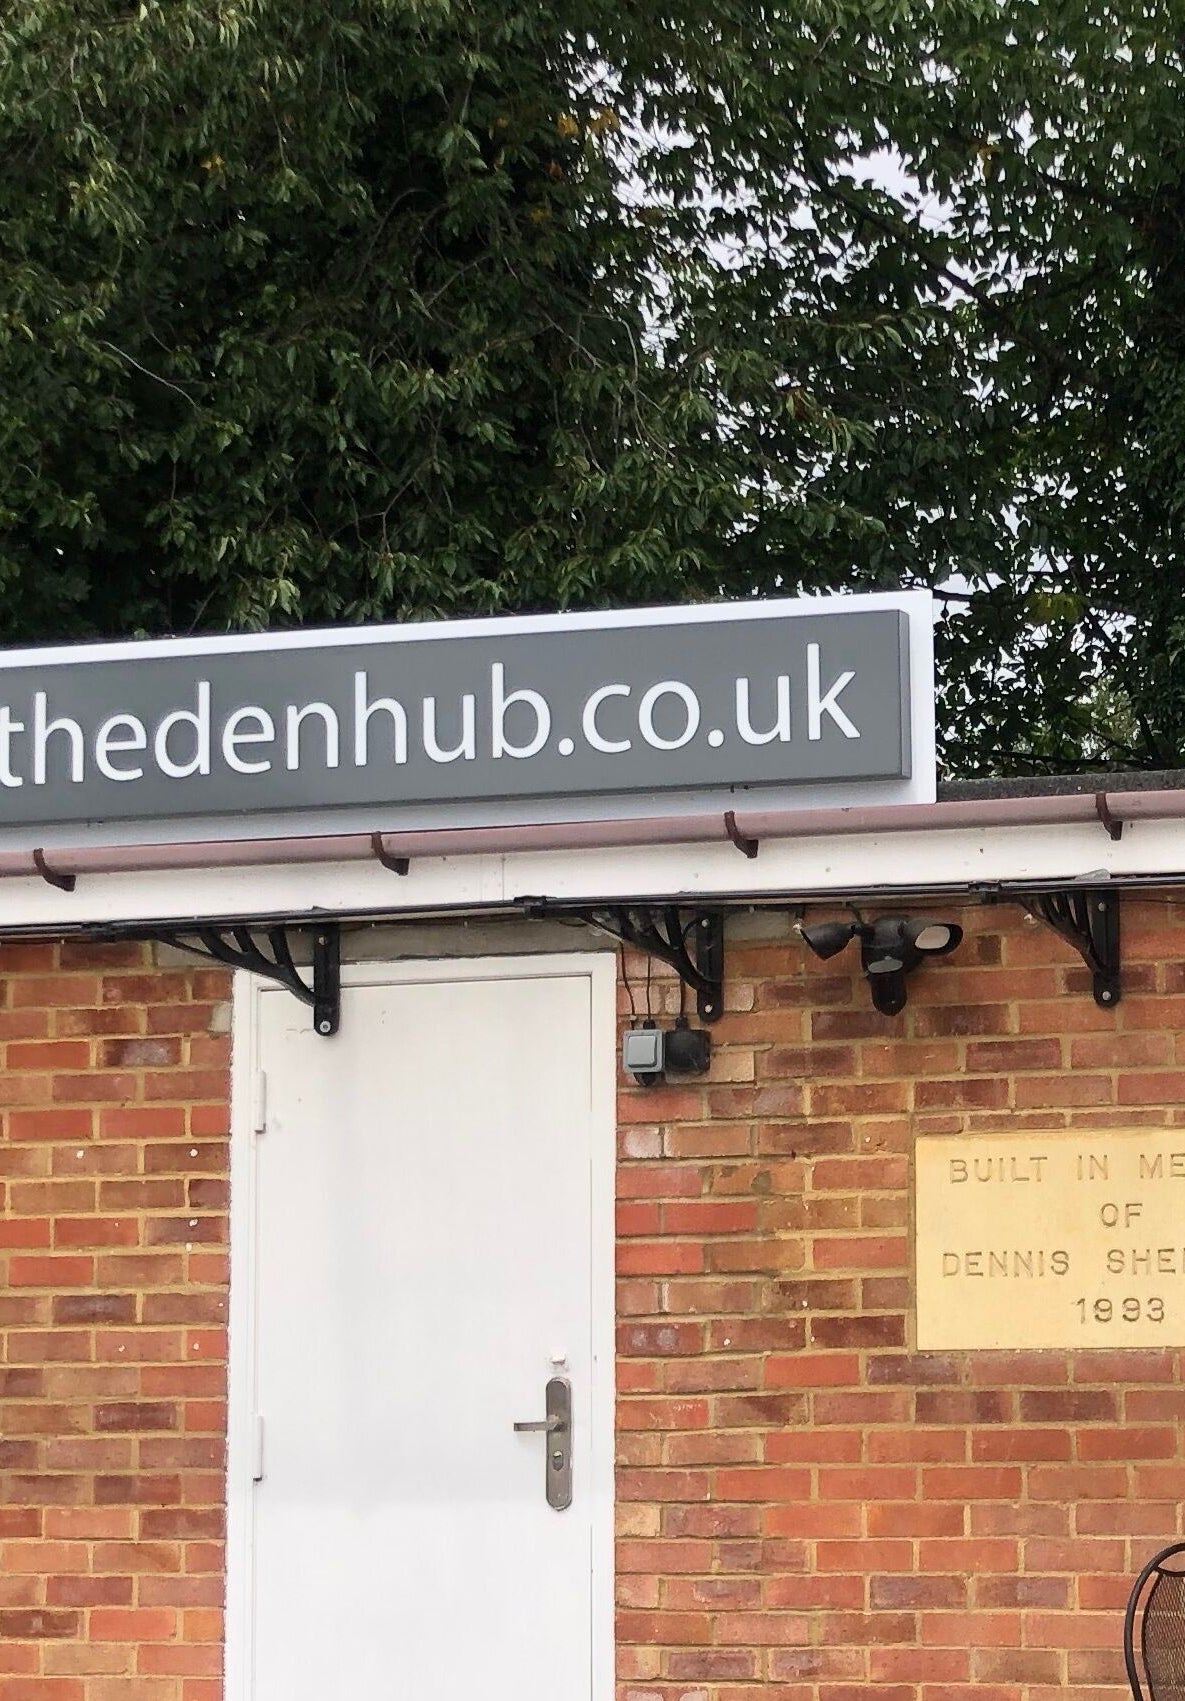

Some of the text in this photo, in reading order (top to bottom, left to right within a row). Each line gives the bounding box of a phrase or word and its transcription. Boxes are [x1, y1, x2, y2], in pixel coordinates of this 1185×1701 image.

[0, 643, 860, 787] thedenhub.co.uk
[949, 1157, 1048, 1184] BUILT
[1077, 1154, 1109, 1181] IN
[1100, 1203, 1143, 1228] OF
[942, 1250, 1070, 1277] DENNIS
[1075, 1297, 1165, 1324] 1993
